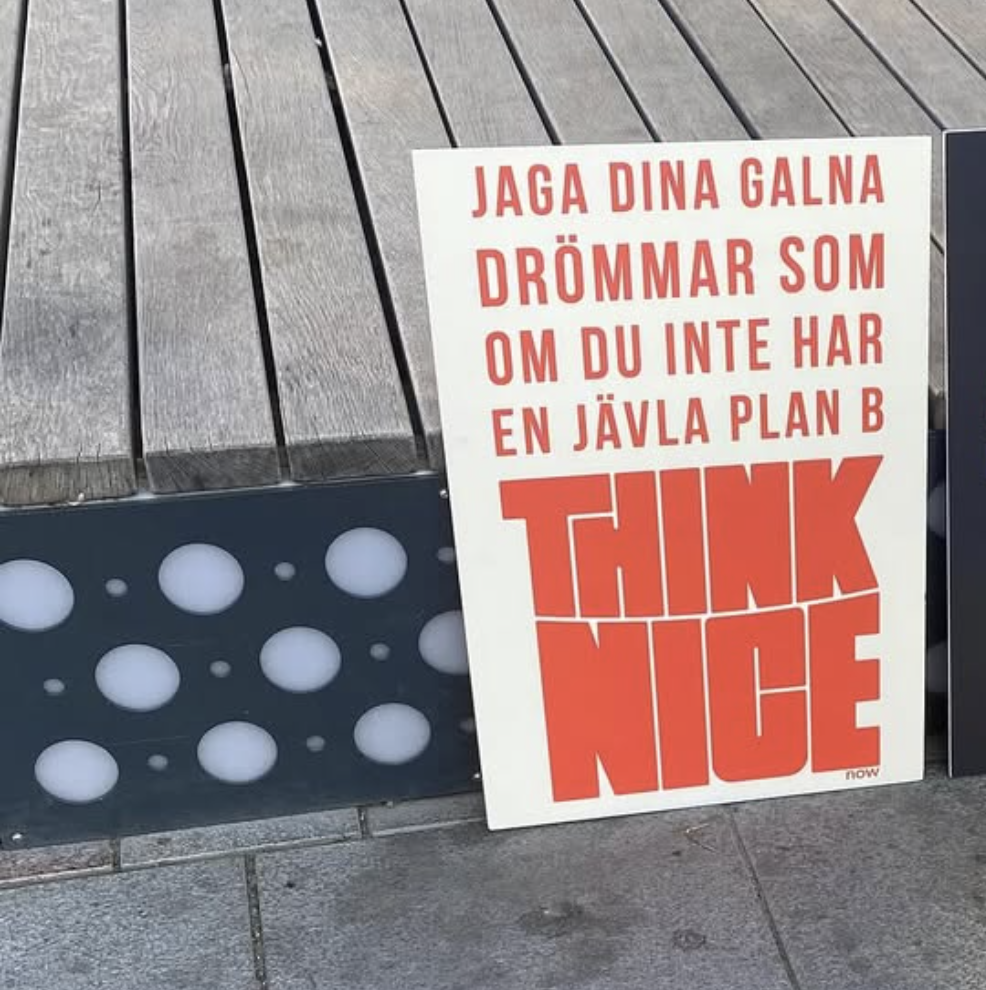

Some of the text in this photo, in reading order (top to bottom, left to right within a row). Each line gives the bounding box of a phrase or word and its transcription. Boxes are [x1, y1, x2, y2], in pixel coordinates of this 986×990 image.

[472, 154, 885, 217] JAGA DINA GALNA
[476, 233, 885, 308] DRÖMMAR SOM
[485, 313, 883, 386] OM DU INTE HAR
[491, 386, 884, 457] EN JÄVLA PLAN B
[499, 455, 884, 618] THINK
[535, 591, 881, 802] NICE
[845, 768, 880, 780] now
